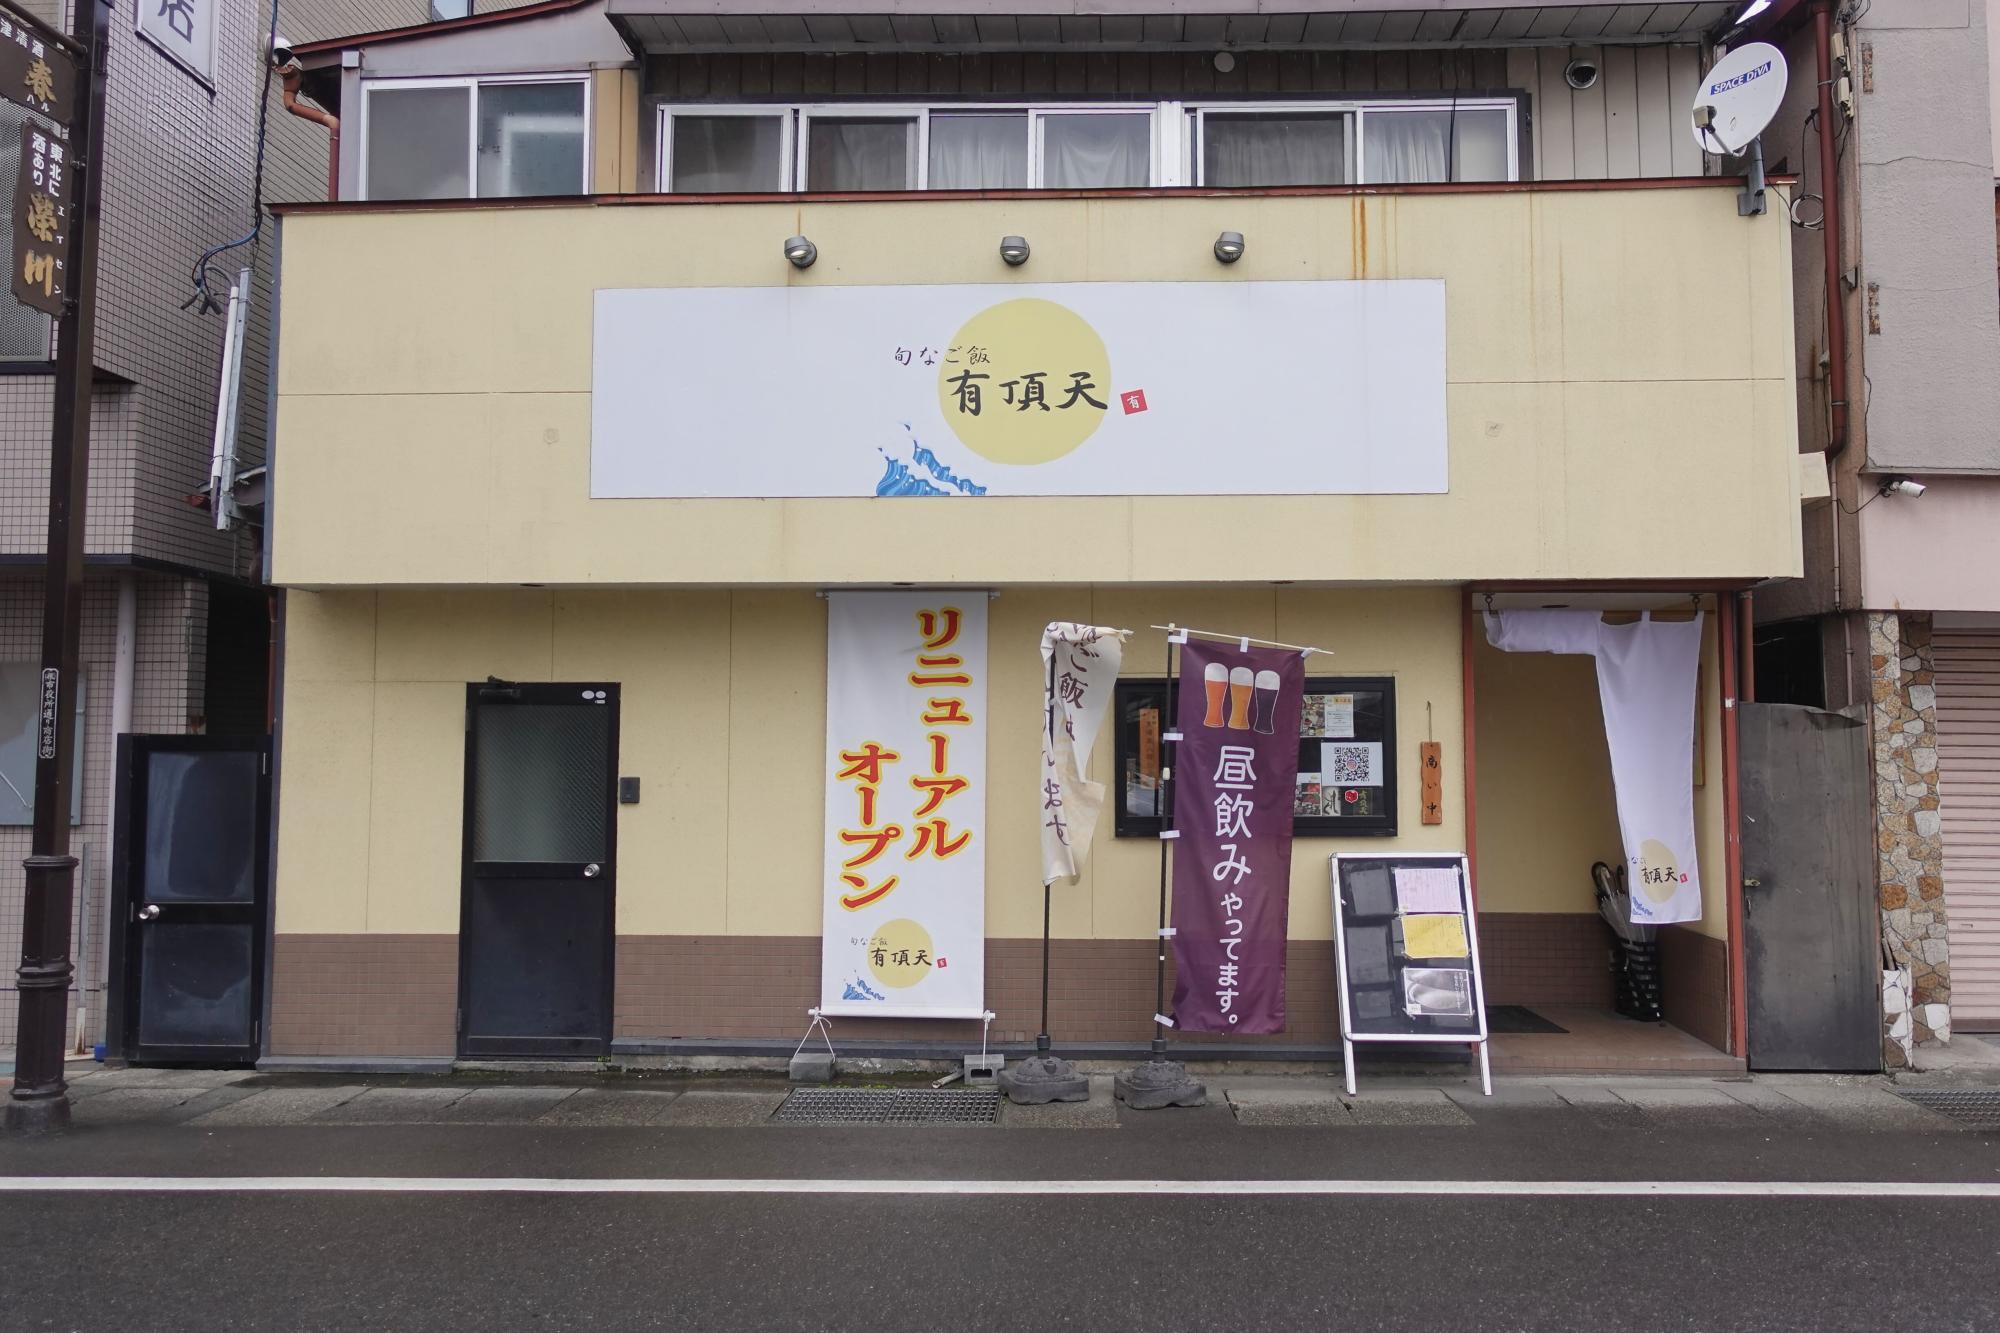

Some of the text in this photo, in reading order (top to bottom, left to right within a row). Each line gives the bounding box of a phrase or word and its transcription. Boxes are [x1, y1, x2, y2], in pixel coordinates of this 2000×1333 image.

[1713, 76, 1743, 94] SPACE
[32, 131, 46, 186] 酒あり
[48, 142, 64, 197] 東北に
[54, 206, 65, 294] エイセン
[895, 346, 990, 365] 旬なご飯
[946, 368, 1108, 416] 有頂天
[905, 607, 973, 861] リニューアル
[1425, 755, 1438, 816] 商い中
[836, 741, 903, 912] オープン
[871, 947, 932, 967] 有頂天
